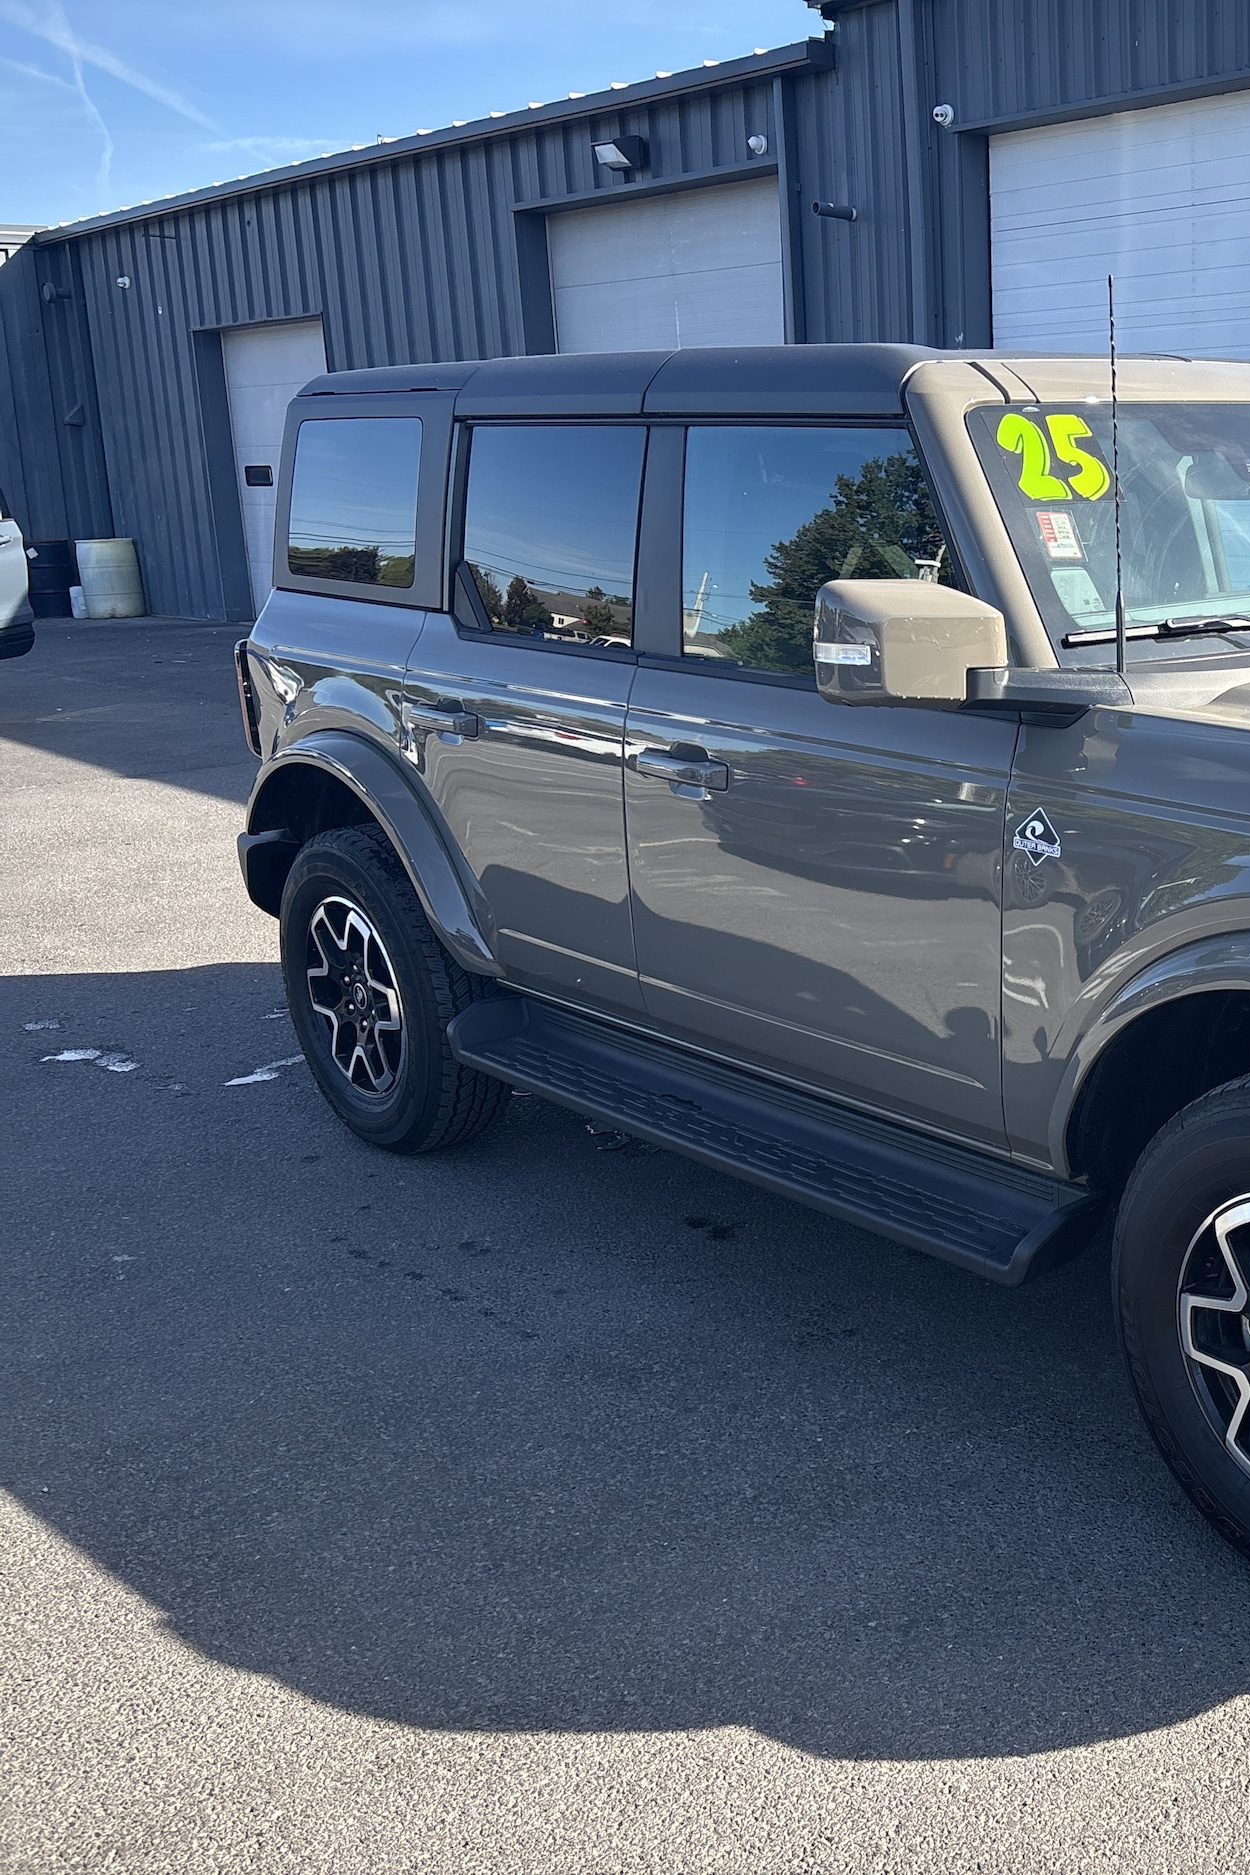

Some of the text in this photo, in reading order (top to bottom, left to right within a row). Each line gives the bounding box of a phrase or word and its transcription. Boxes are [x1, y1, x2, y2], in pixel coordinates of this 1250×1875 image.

[996, 413, 1111, 501] 25
[1015, 839, 1058, 854] OUTER BANKS
